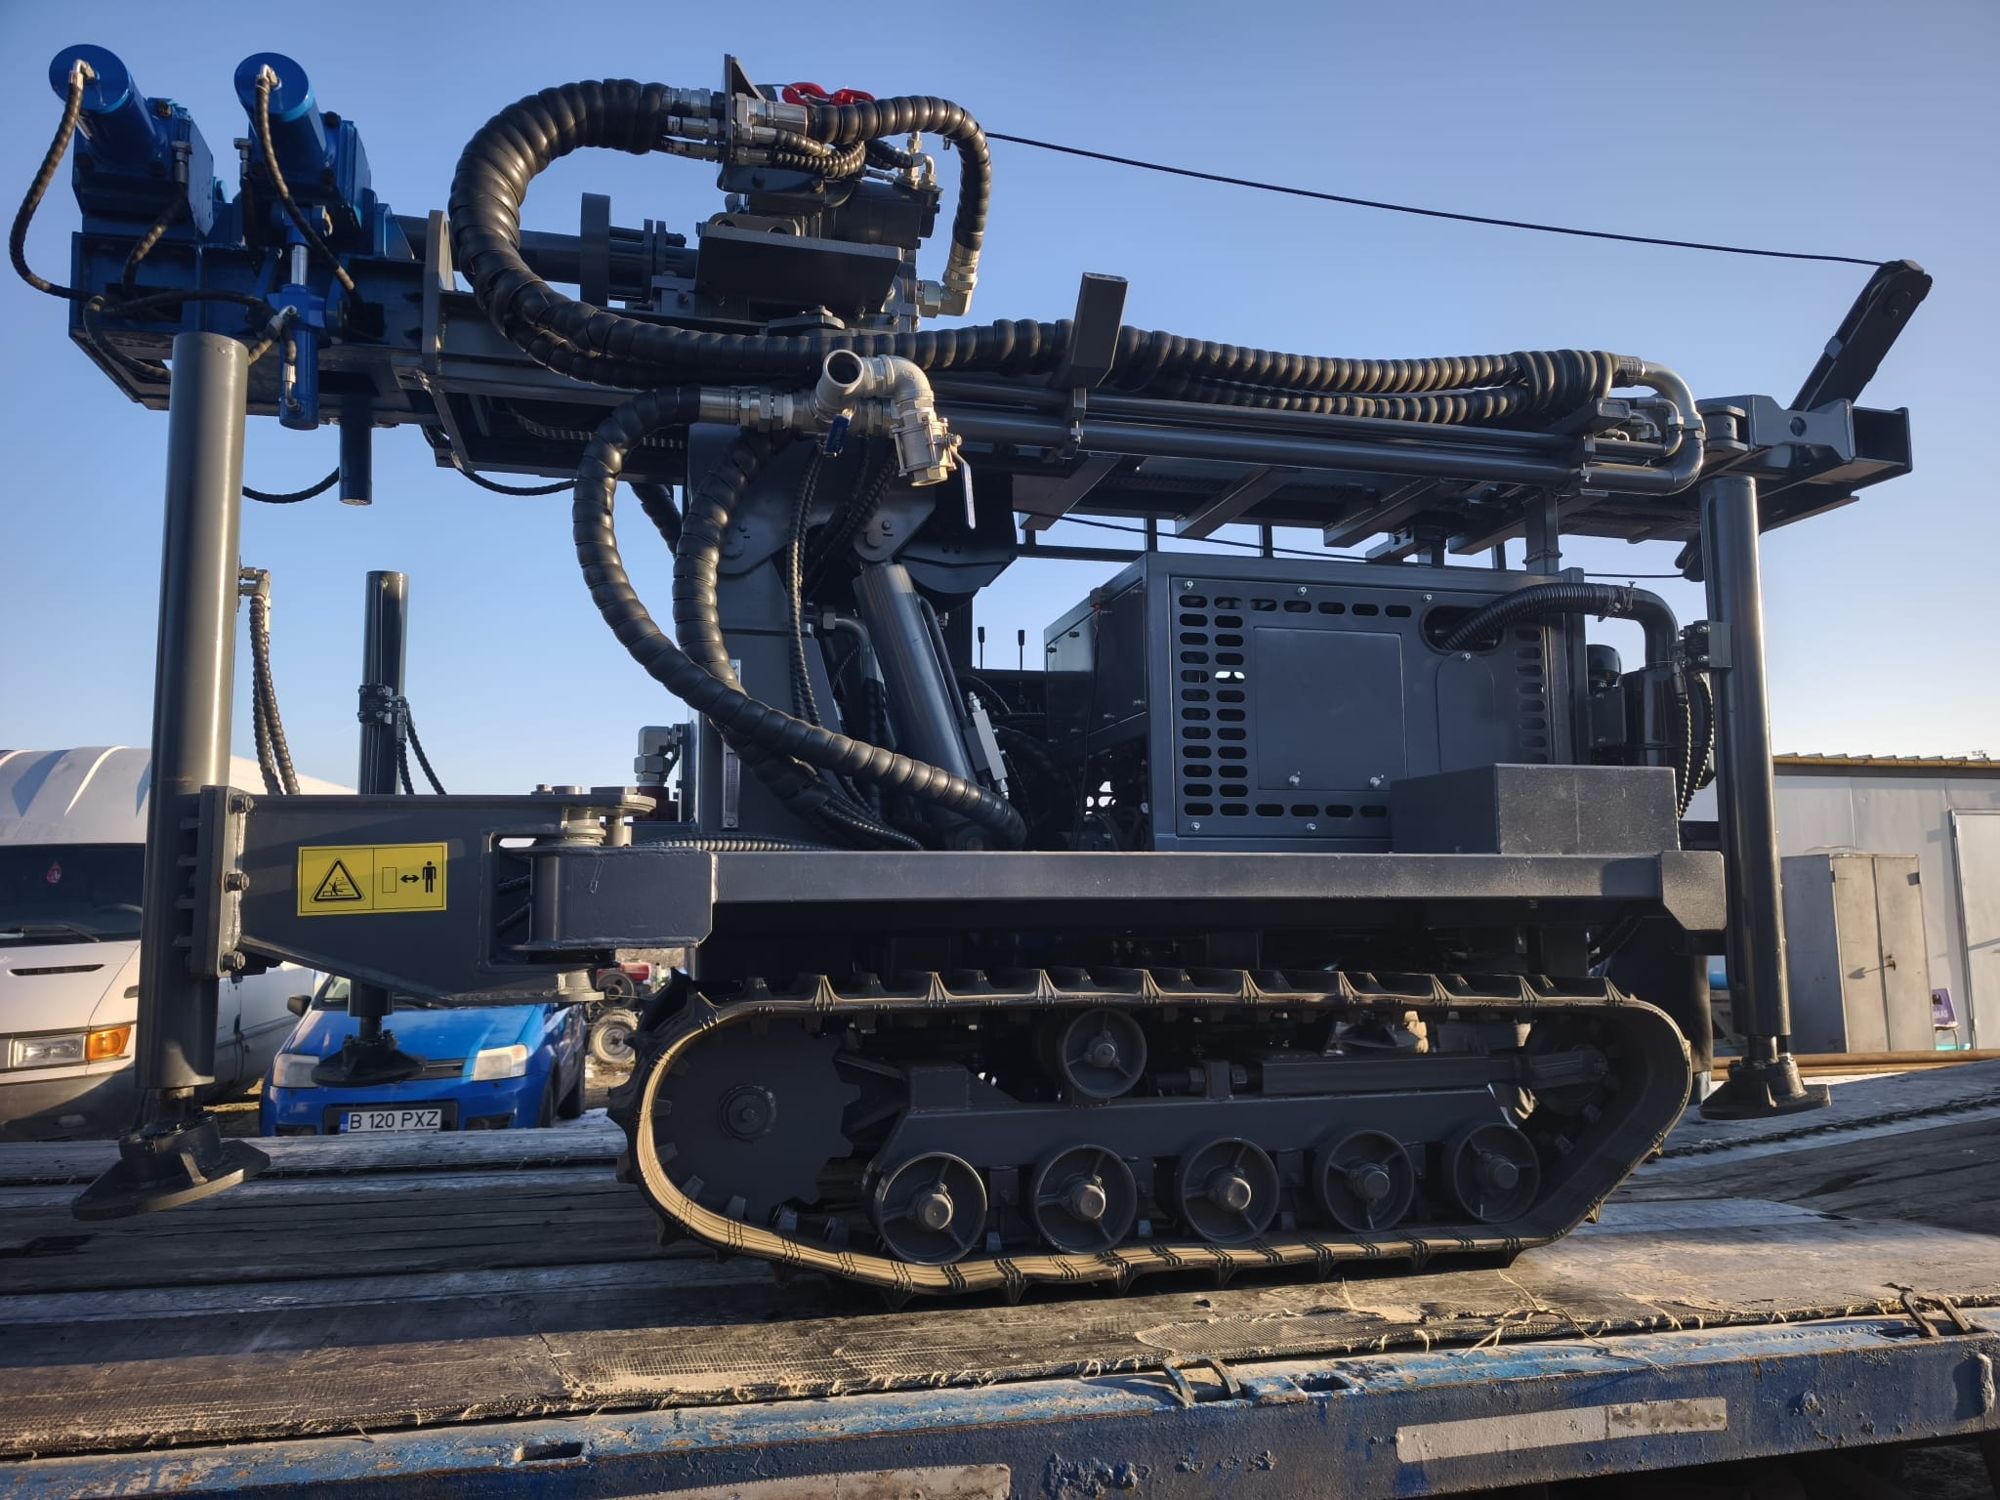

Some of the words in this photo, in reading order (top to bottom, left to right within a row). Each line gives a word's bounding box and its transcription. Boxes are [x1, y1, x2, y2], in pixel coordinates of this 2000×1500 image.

[350, 1114, 362, 1130] B
[369, 1113, 396, 1129] 120
[401, 1111, 439, 1128] PXZ
